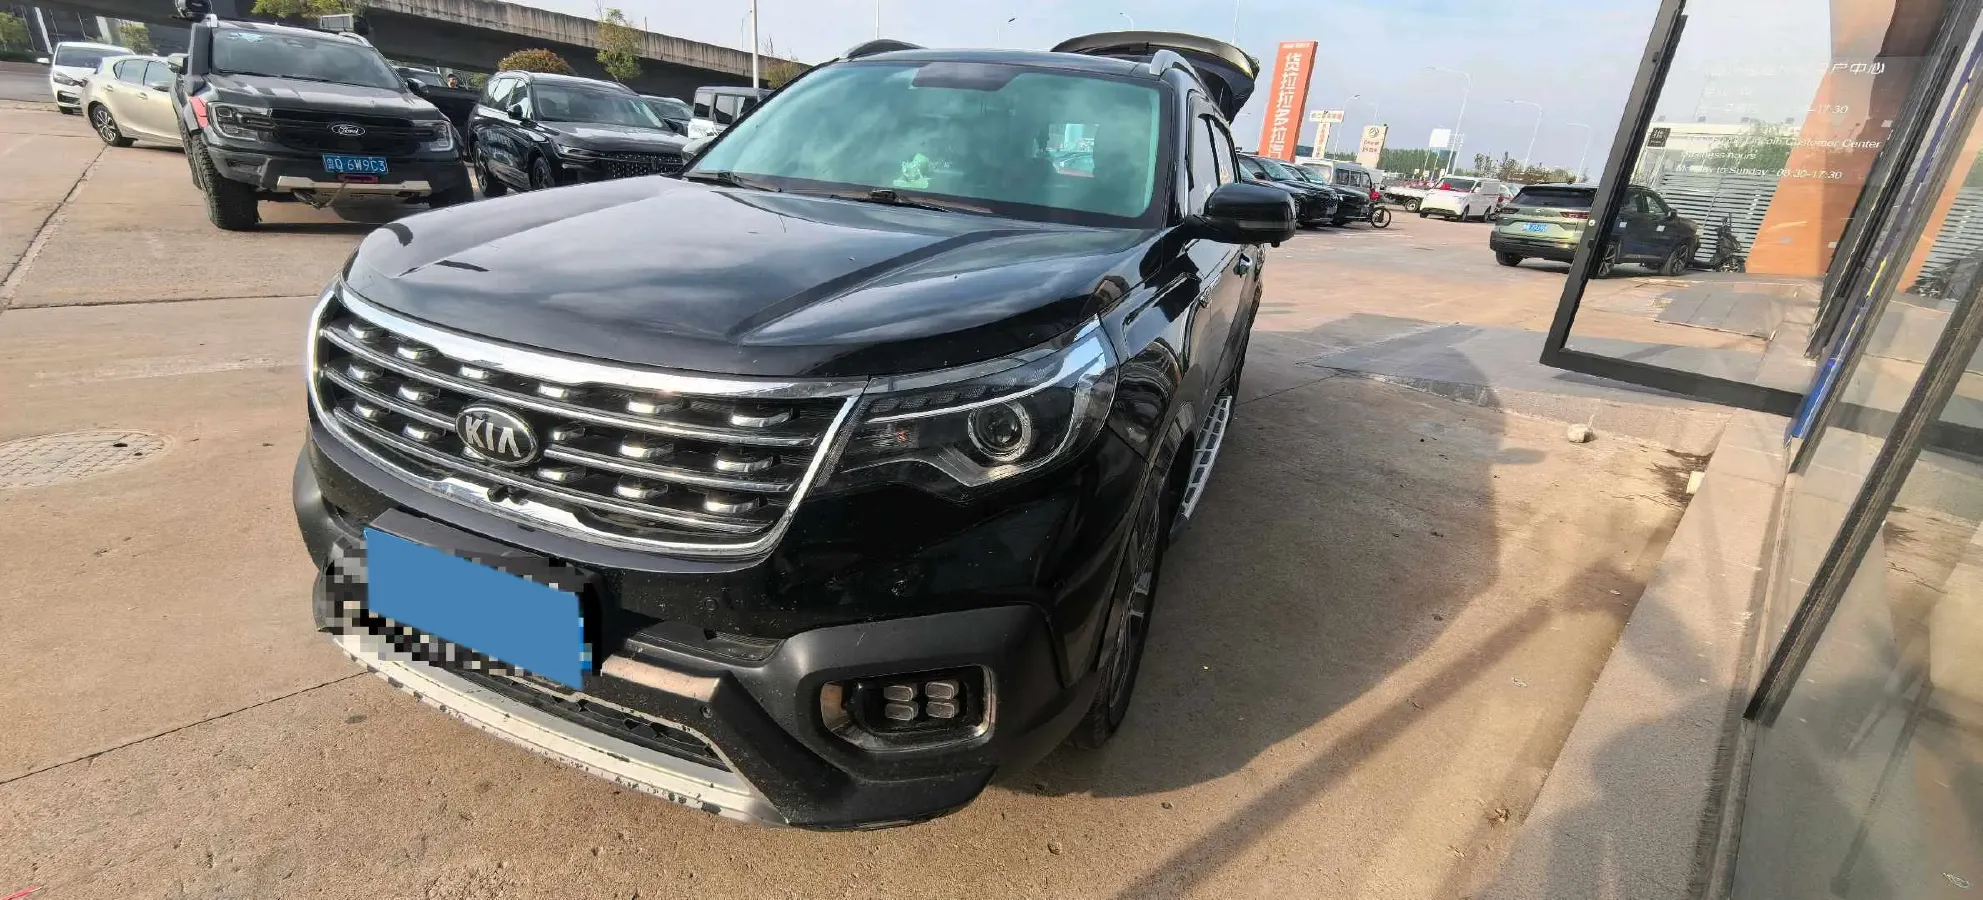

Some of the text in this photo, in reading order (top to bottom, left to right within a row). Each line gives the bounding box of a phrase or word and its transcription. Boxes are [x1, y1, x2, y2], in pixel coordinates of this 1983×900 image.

[1786, 138, 1838, 148] Customer
[1842, 139, 1881, 149] Center
[1729, 166, 1769, 176] Sunday
[465, 415, 521, 458] KIA
